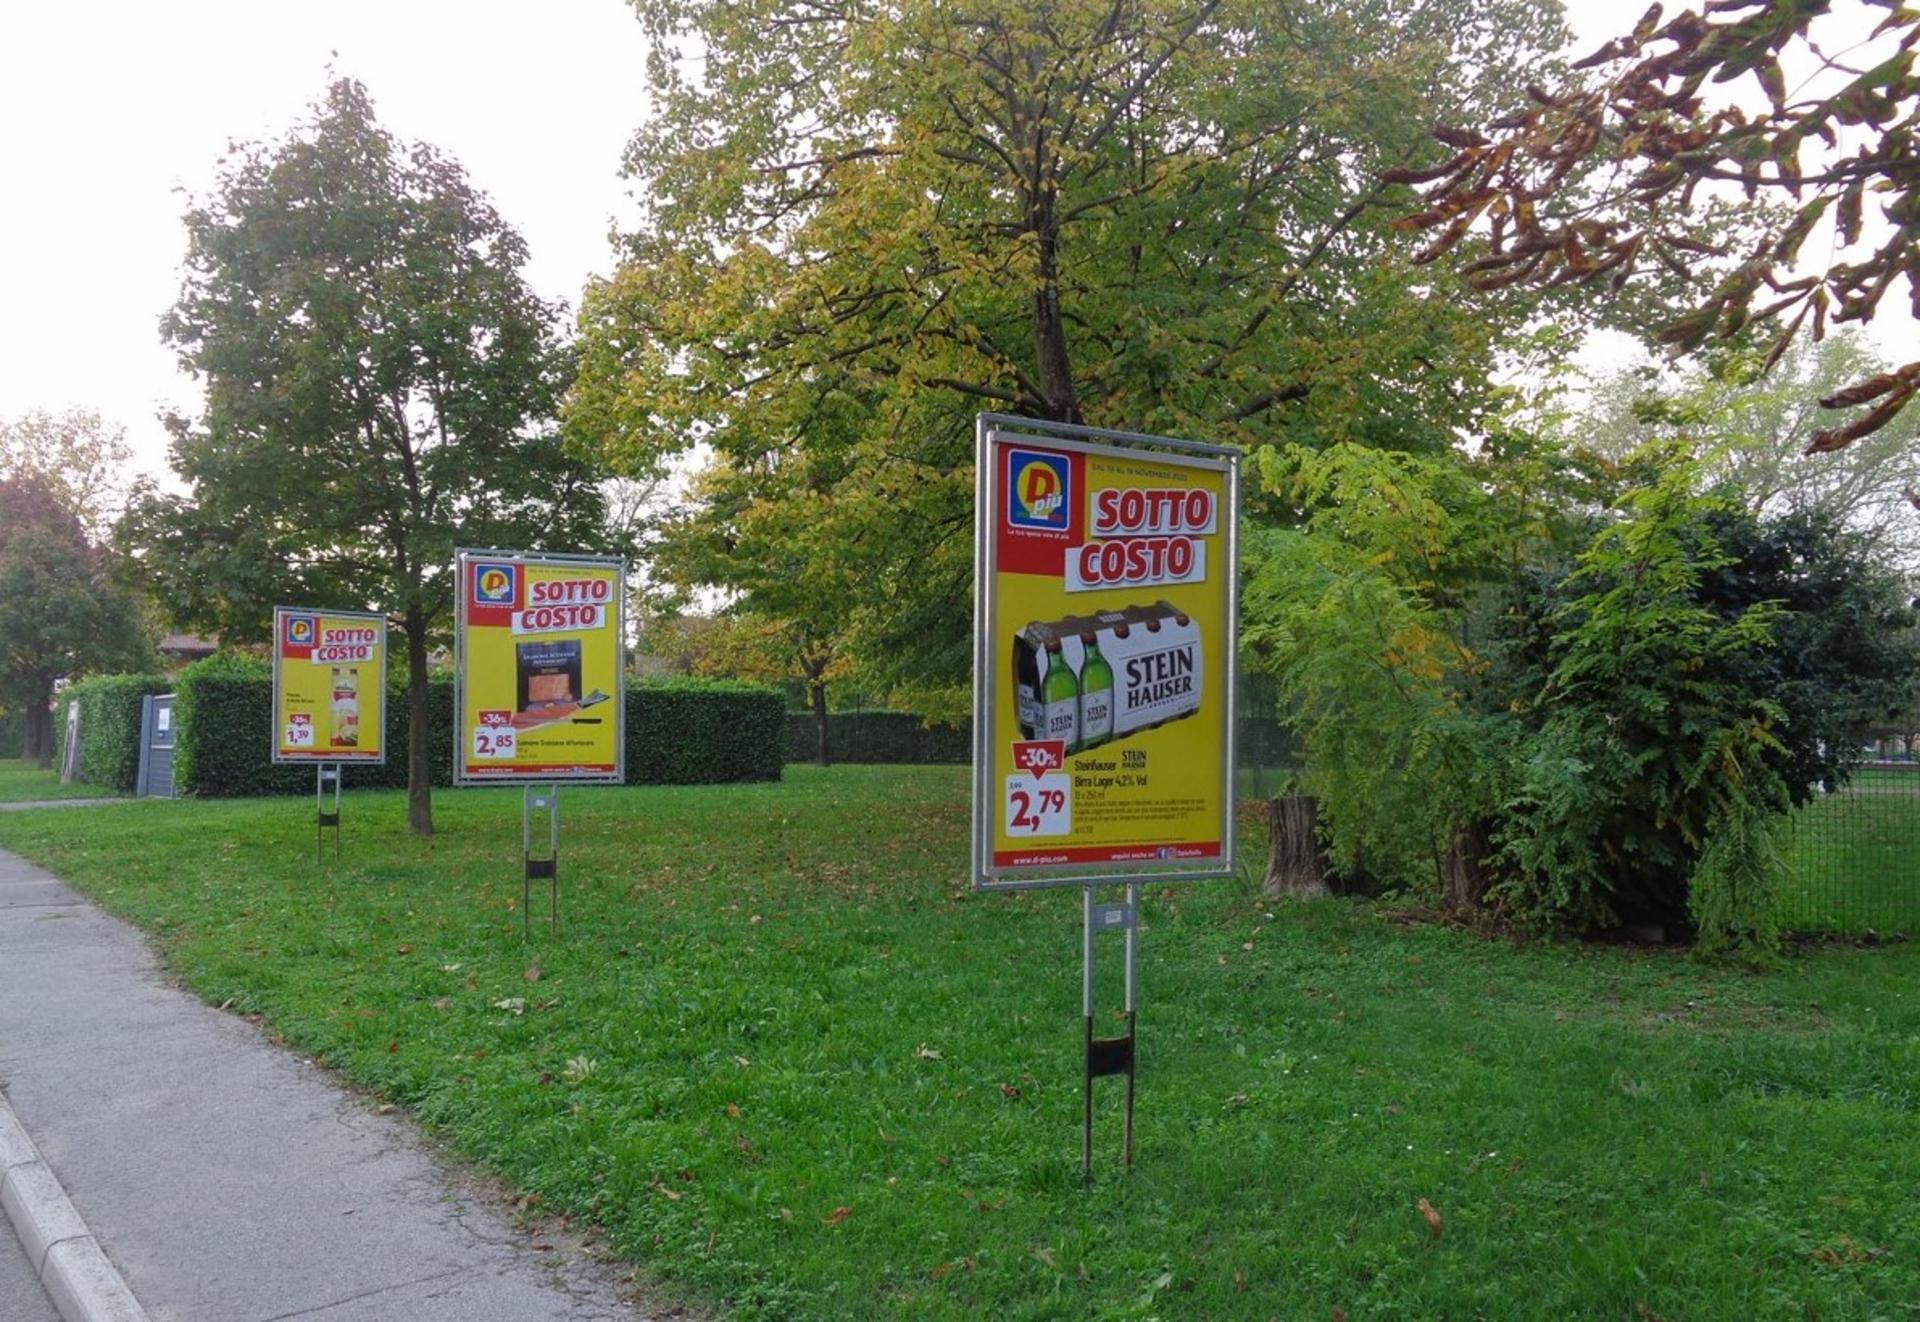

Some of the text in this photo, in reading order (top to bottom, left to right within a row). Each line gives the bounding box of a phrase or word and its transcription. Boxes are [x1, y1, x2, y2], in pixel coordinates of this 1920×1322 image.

[1097, 488, 1210, 529] SOTTO
[1079, 537, 1193, 583] COSTO
[532, 579, 608, 602] SOTTO
[521, 605, 596, 630] COSTO
[325, 629, 375, 642] SOTTO
[318, 646, 367, 661] COSTO
[1126, 647, 1193, 688] STEIN
[1127, 676, 1192, 710] HAUSER
[1051, 713, 1073, 727] STEIN
[477, 735, 513, 756] 2,85
[1122, 750, 1147, 761] STEIN
[1021, 748, 1058, 767] -30%
[1075, 760, 1117, 772] Steinhauser
[1075, 777, 1092, 788] Birra
[1094, 776, 1115, 789] Lager
[1136, 775, 1147, 786] Vol
[1010, 790, 1065, 831] 2,79
